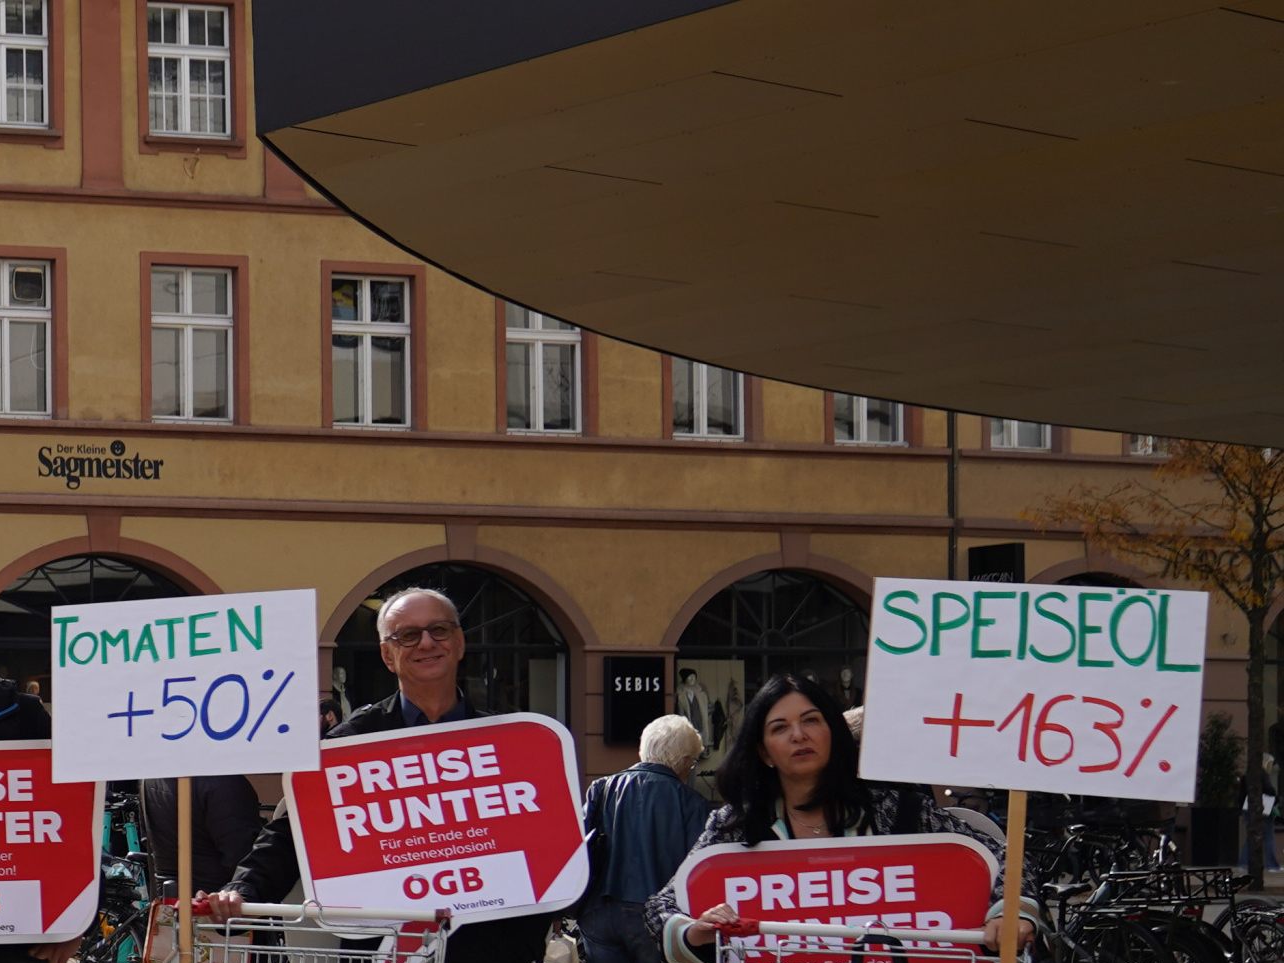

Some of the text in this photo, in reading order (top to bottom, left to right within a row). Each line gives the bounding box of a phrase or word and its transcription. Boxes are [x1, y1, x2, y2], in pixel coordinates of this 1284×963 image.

[38, 446, 164, 490] Sagmeister
[57, 444, 107, 455] Der Kleine
[53, 604, 262, 667] TOMATEN
[874, 588, 1201, 672] SPEISEÖL
[107, 669, 295, 742] +50%
[614, 676, 660, 692] SEBIS
[922, 692, 1179, 778] +163%
[325, 744, 501, 806] PREISE
[333, 781, 541, 854] RUNTER
[379, 826, 489, 850] Für ein Ende der
[382, 839, 497, 865] Kostenexplosion!
[452, 897, 505, 911] Vorarlberg
[724, 865, 916, 914] PREISE
